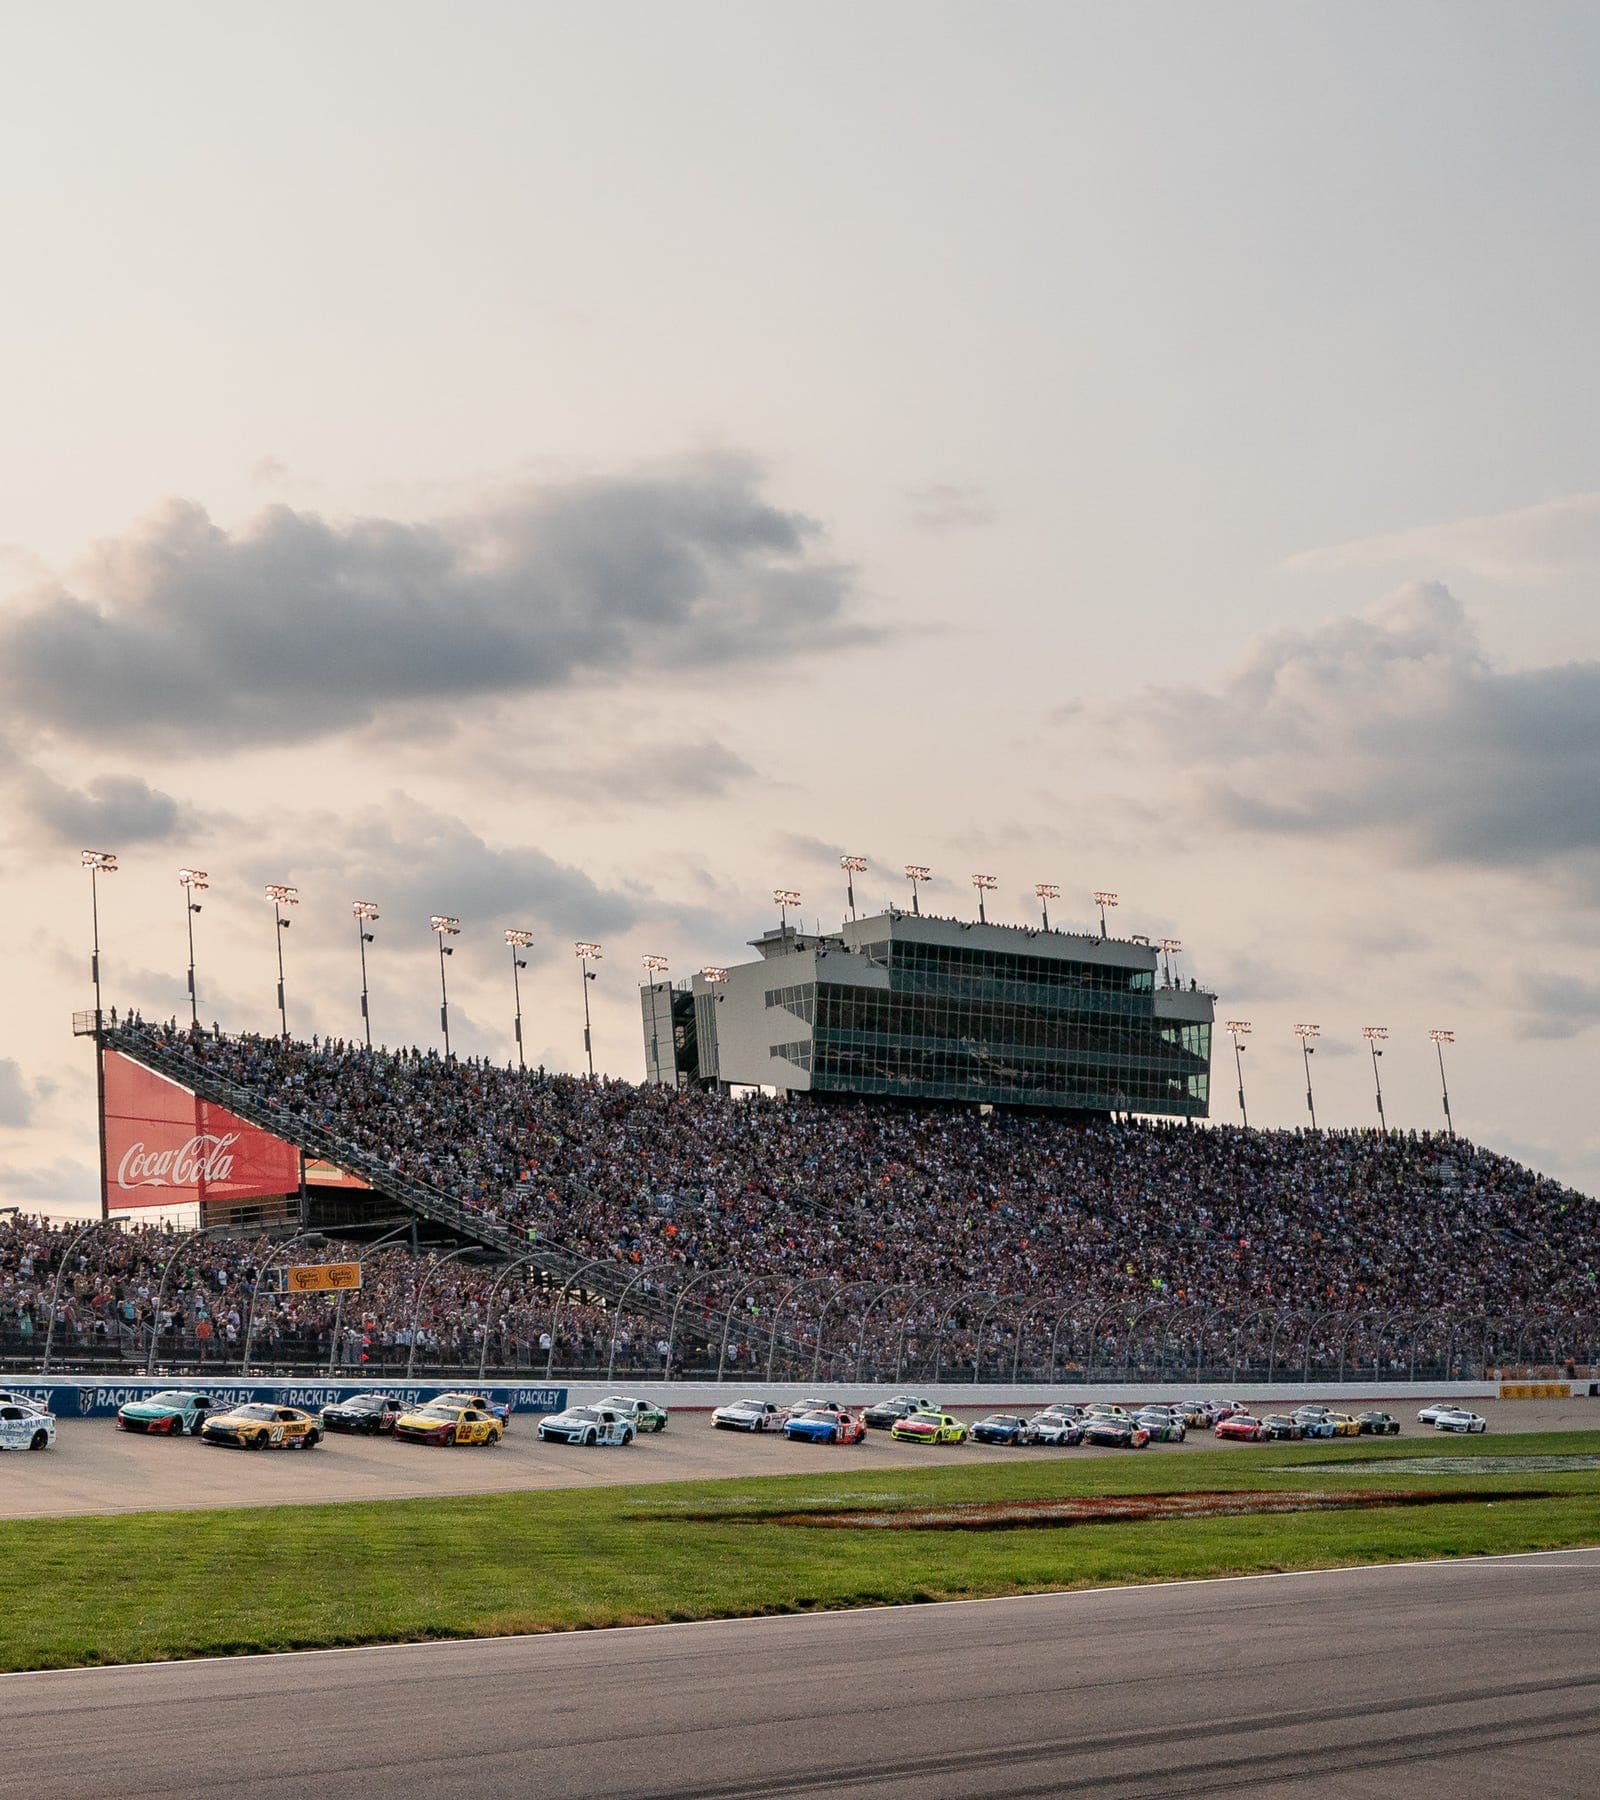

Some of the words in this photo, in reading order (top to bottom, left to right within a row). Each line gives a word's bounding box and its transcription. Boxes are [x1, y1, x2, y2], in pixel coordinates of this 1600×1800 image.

[289, 1390, 341, 1406] RACKLEY
[519, 1391, 560, 1405] RACKLEY
[763, 1416, 771, 1427] 2
[270, 1426, 285, 1442] 20
[457, 1425, 472, 1440] 22
